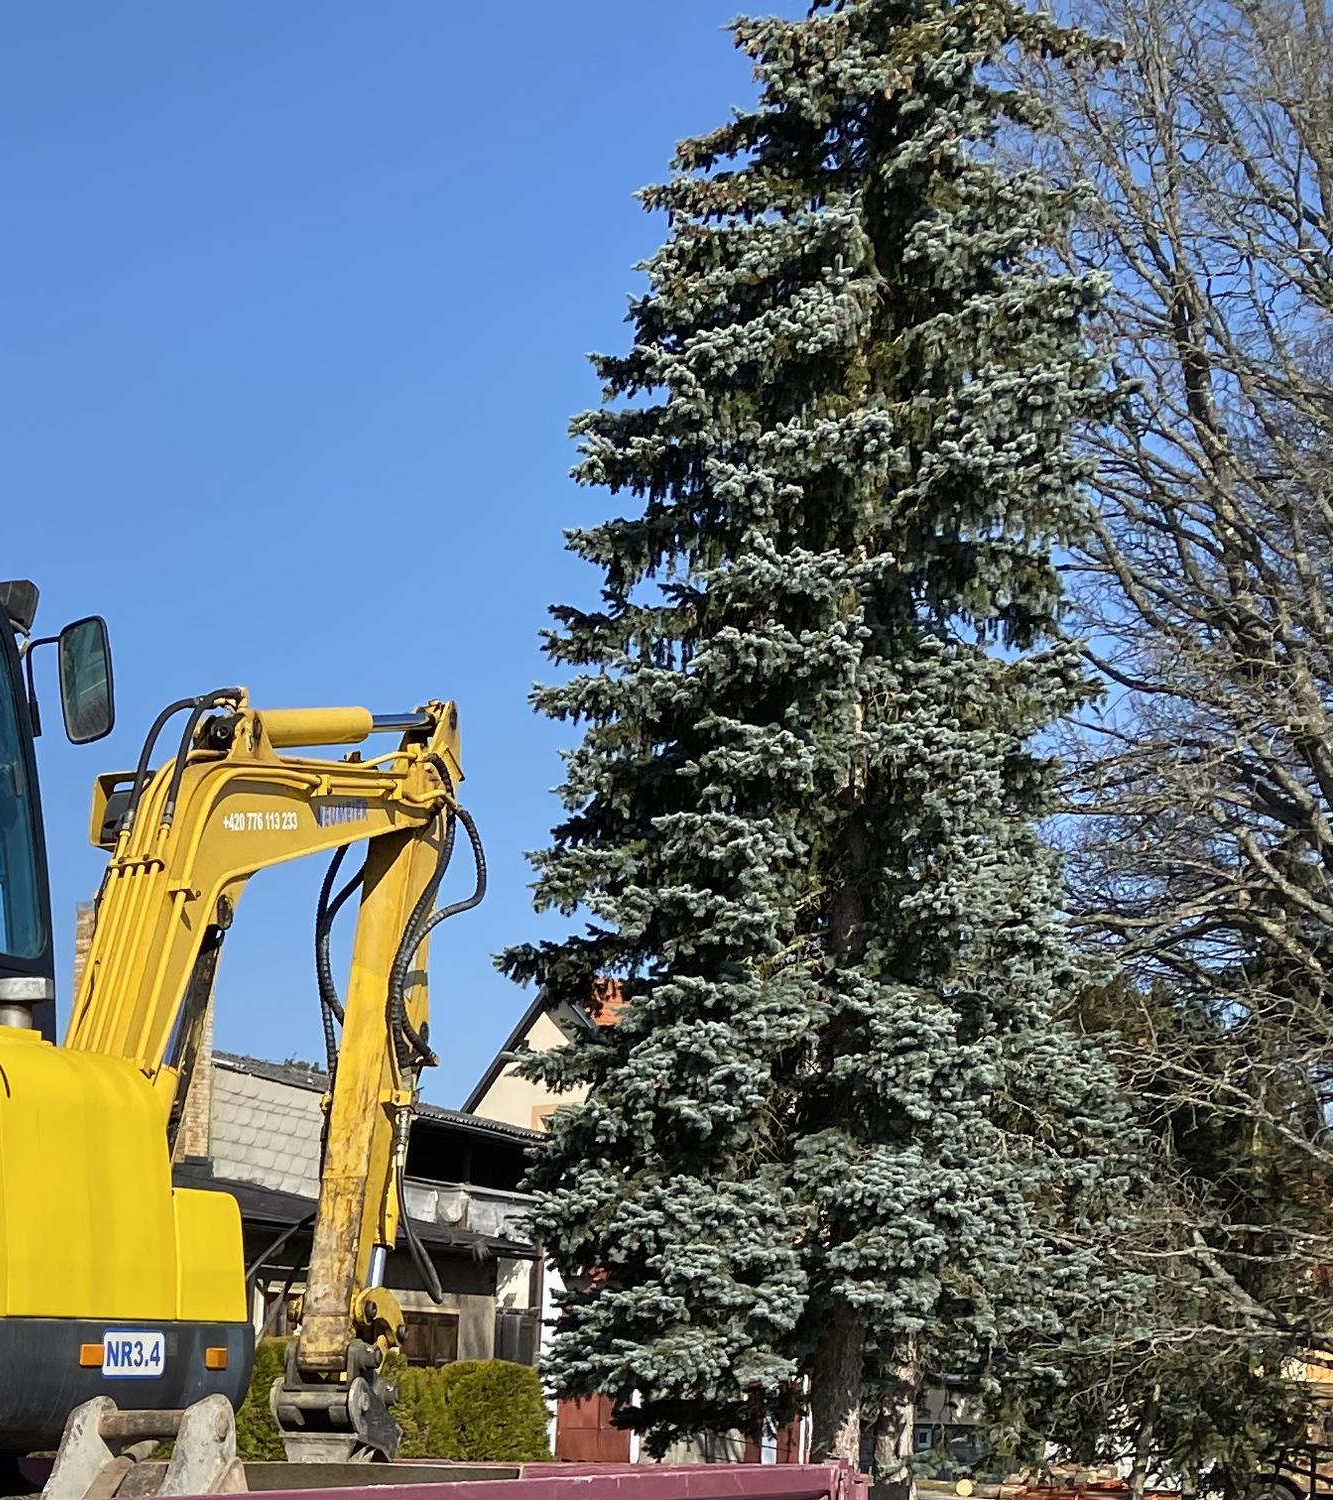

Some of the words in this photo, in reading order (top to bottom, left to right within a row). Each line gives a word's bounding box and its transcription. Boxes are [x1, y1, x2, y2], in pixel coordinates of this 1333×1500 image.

[222, 811, 246, 832] +420
[247, 812, 264, 831] 776
[265, 812, 281, 831] 113
[282, 811, 299, 831] 233
[106, 1340, 161, 1367] NR3.4
